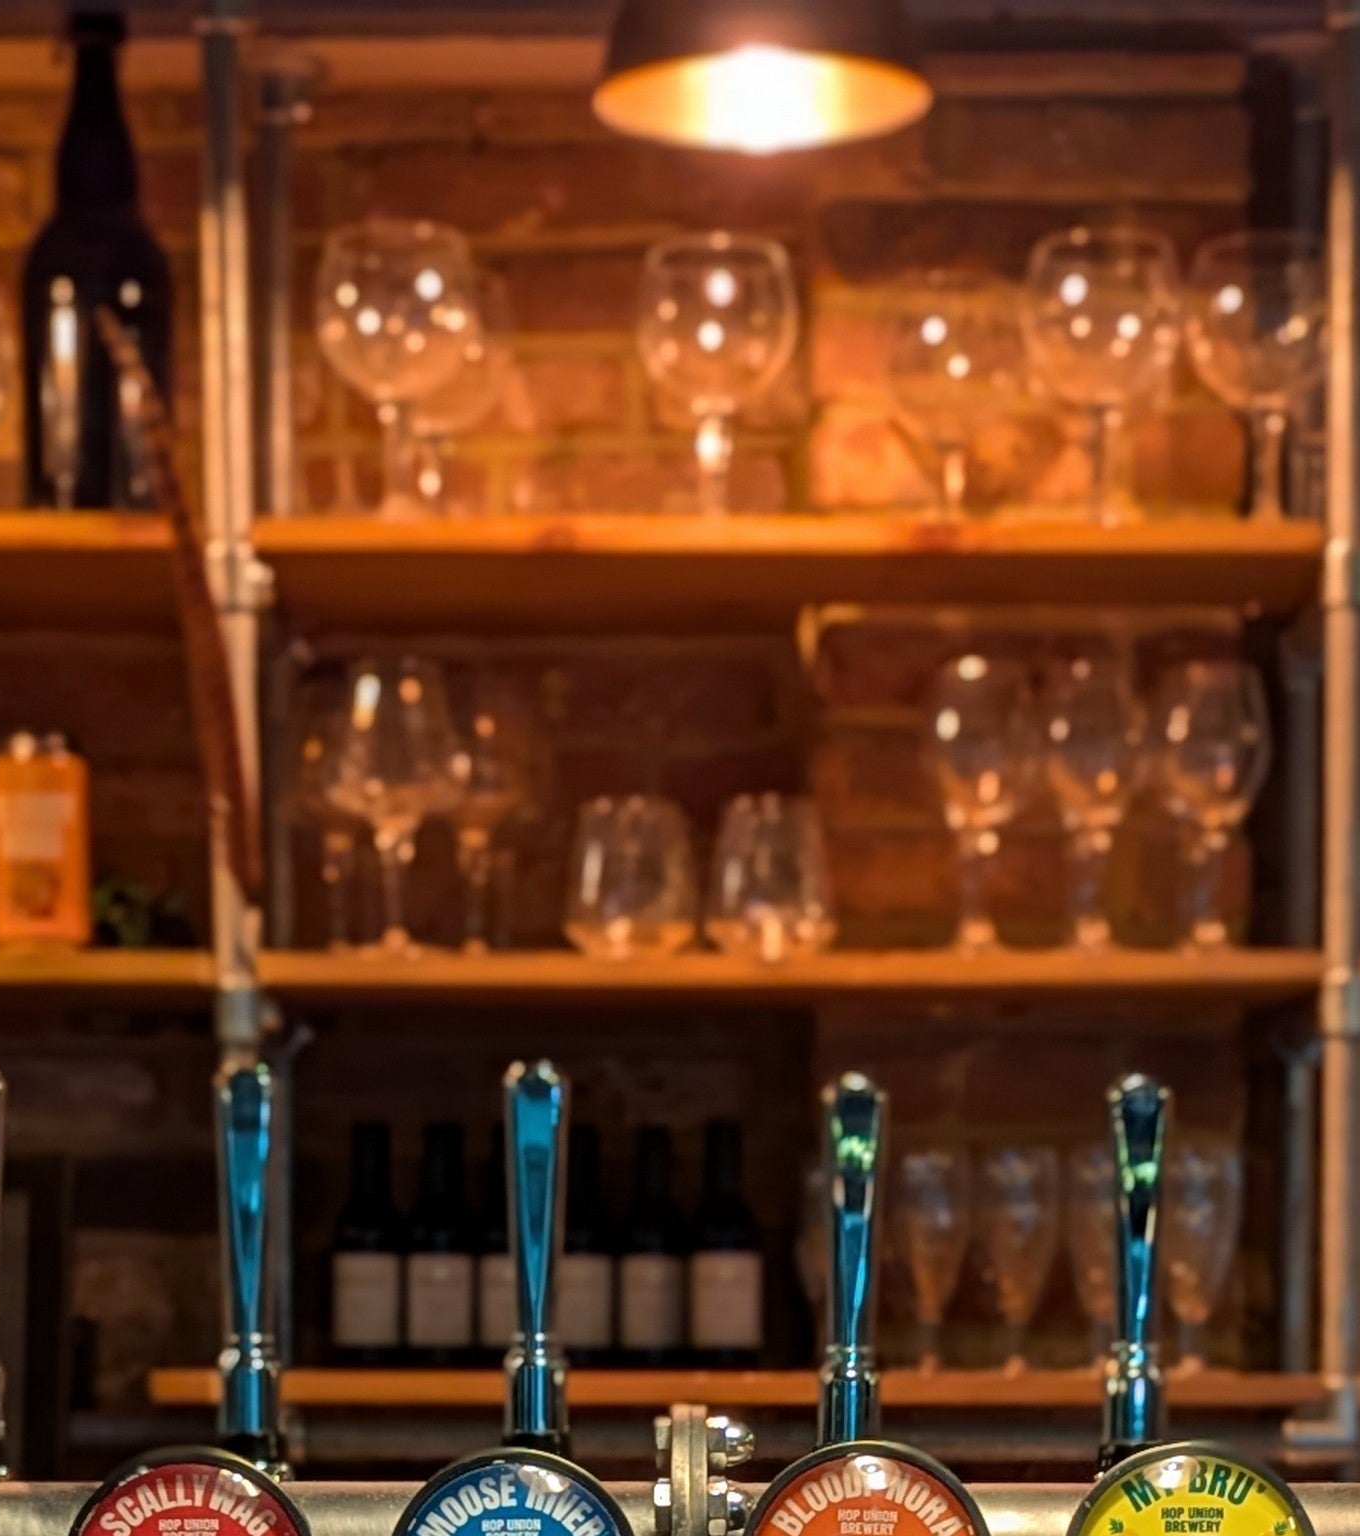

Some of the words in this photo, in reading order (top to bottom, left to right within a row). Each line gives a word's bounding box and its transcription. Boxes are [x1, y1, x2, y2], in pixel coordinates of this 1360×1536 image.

[837, 1509, 860, 1522] HOP
[863, 1510, 898, 1522] UNION
[1160, 1507, 1184, 1519] HOP
[1188, 1507, 1224, 1519] UNION
[158, 1519, 181, 1531] HOP
[184, 1519, 219, 1531] UNION
[481, 1520, 504, 1532] HOP
[506, 1519, 541, 1531] UNION
[840, 1522, 894, 1535] BREWERY
[1165, 1520, 1221, 1533] BREWERY
